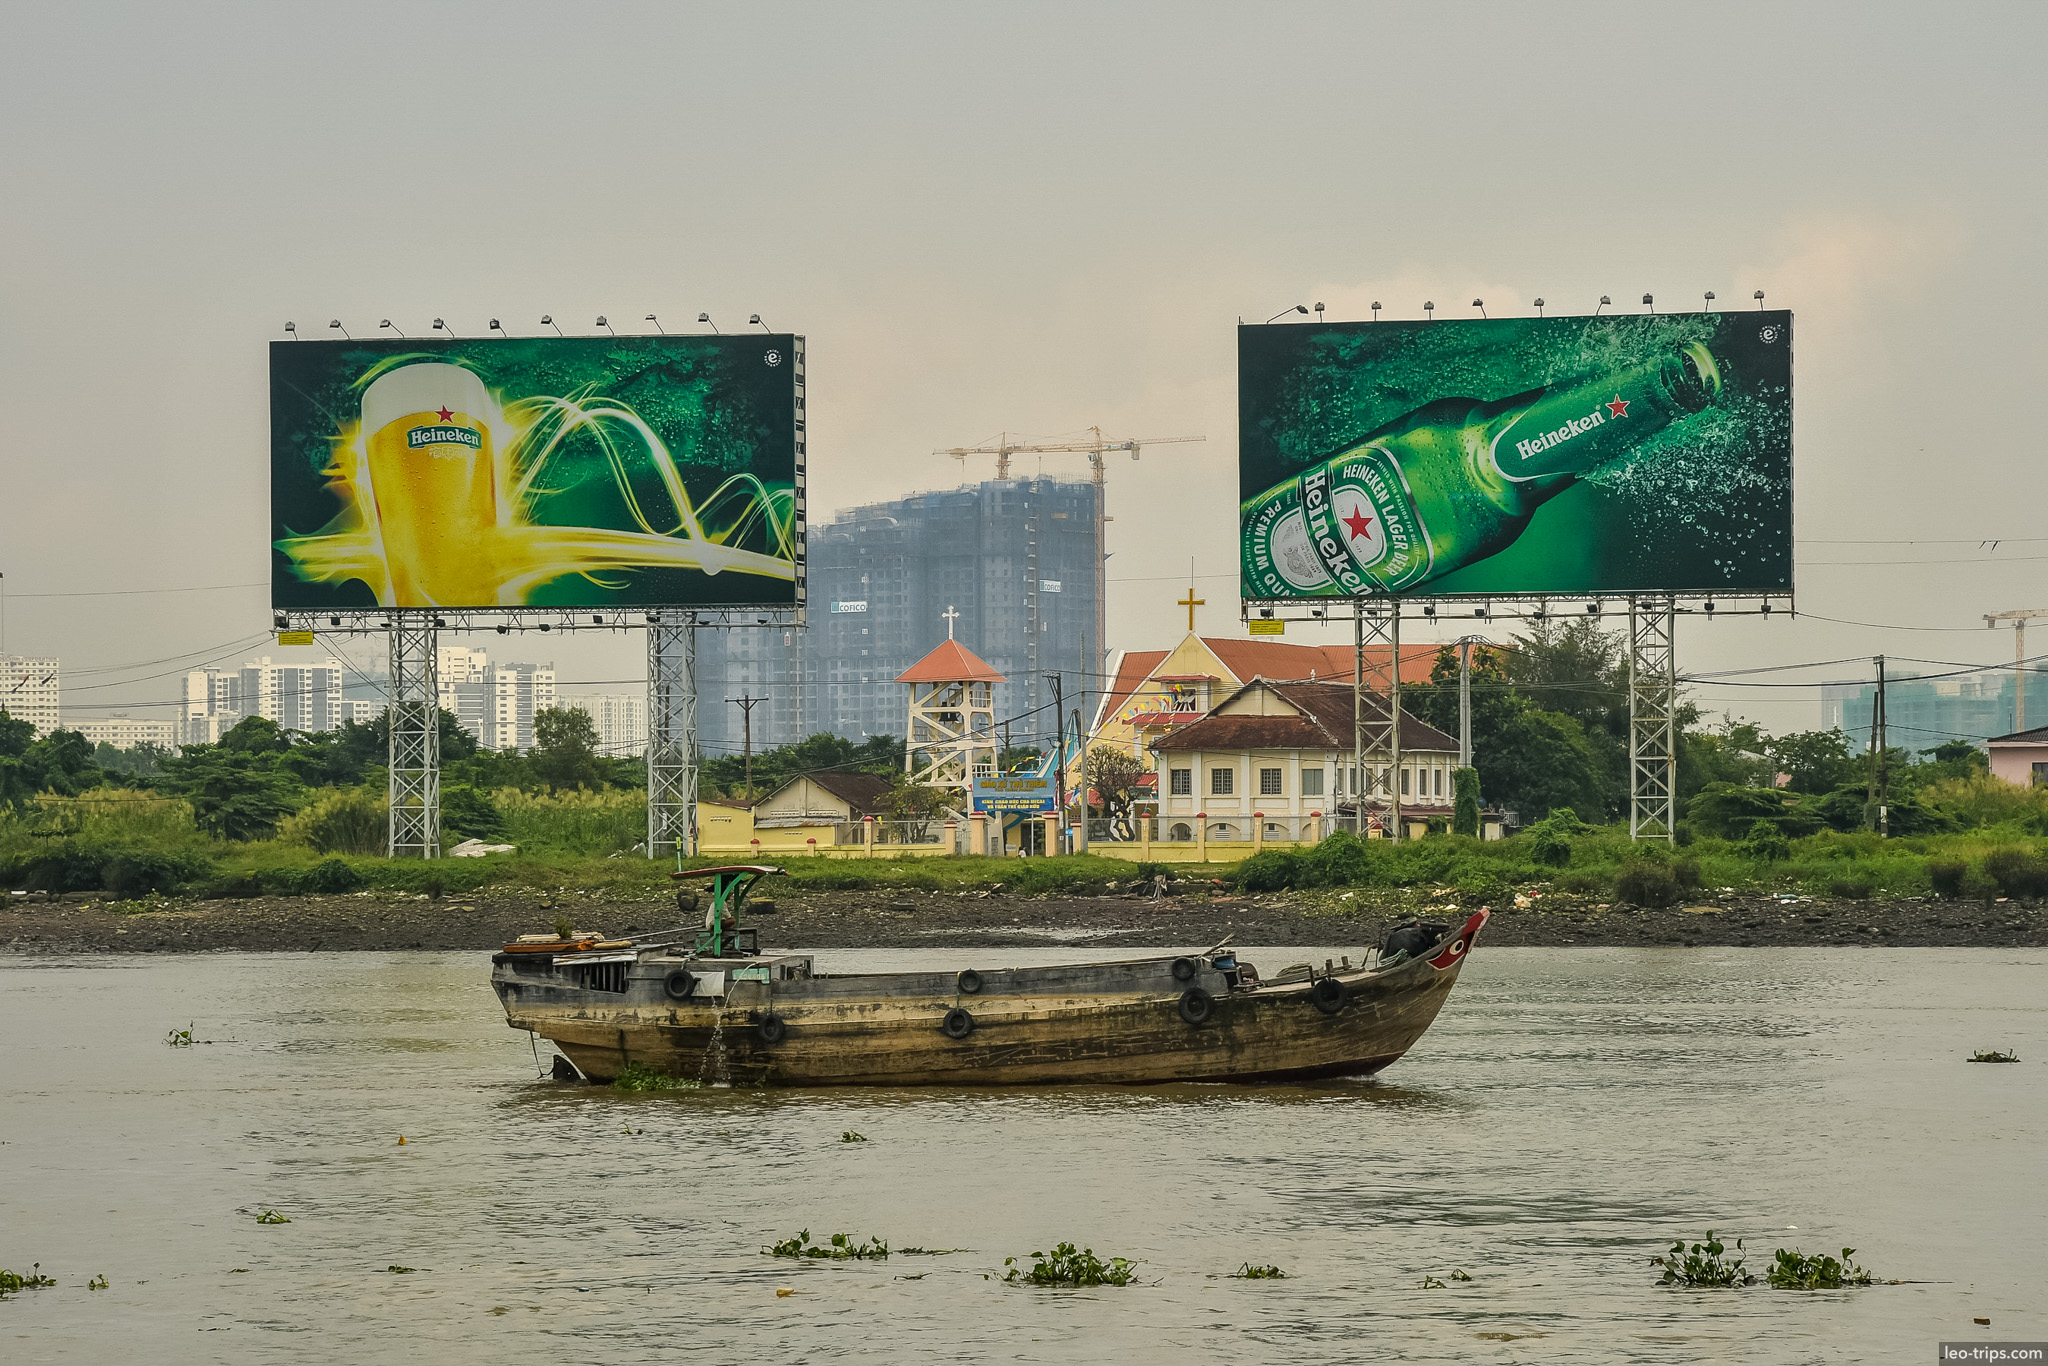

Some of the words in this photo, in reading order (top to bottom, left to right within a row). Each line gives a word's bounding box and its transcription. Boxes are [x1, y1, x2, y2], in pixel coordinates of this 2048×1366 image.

[411, 428, 480, 446] Heineken
[1515, 411, 1606, 460] Heineken
[1343, 464, 1390, 504] HEINEKEN
[1388, 478, 1399, 494] WITH
[1395, 494, 1409, 520] PASSION
[1406, 521, 1414, 533] FOR
[1245, 511, 1258, 538] ORIGINAL
[1253, 500, 1282, 571] PREMIUM
[1304, 468, 1374, 596] Heineken
[1382, 504, 1409, 550] LAGER
[1248, 563, 1257, 580] WITH
[1383, 551, 1410, 577] BEER
[1044, 584, 1061, 592] COFICO
[1264, 572, 1296, 597] QUA
[840, 604, 866, 612] COFICO
